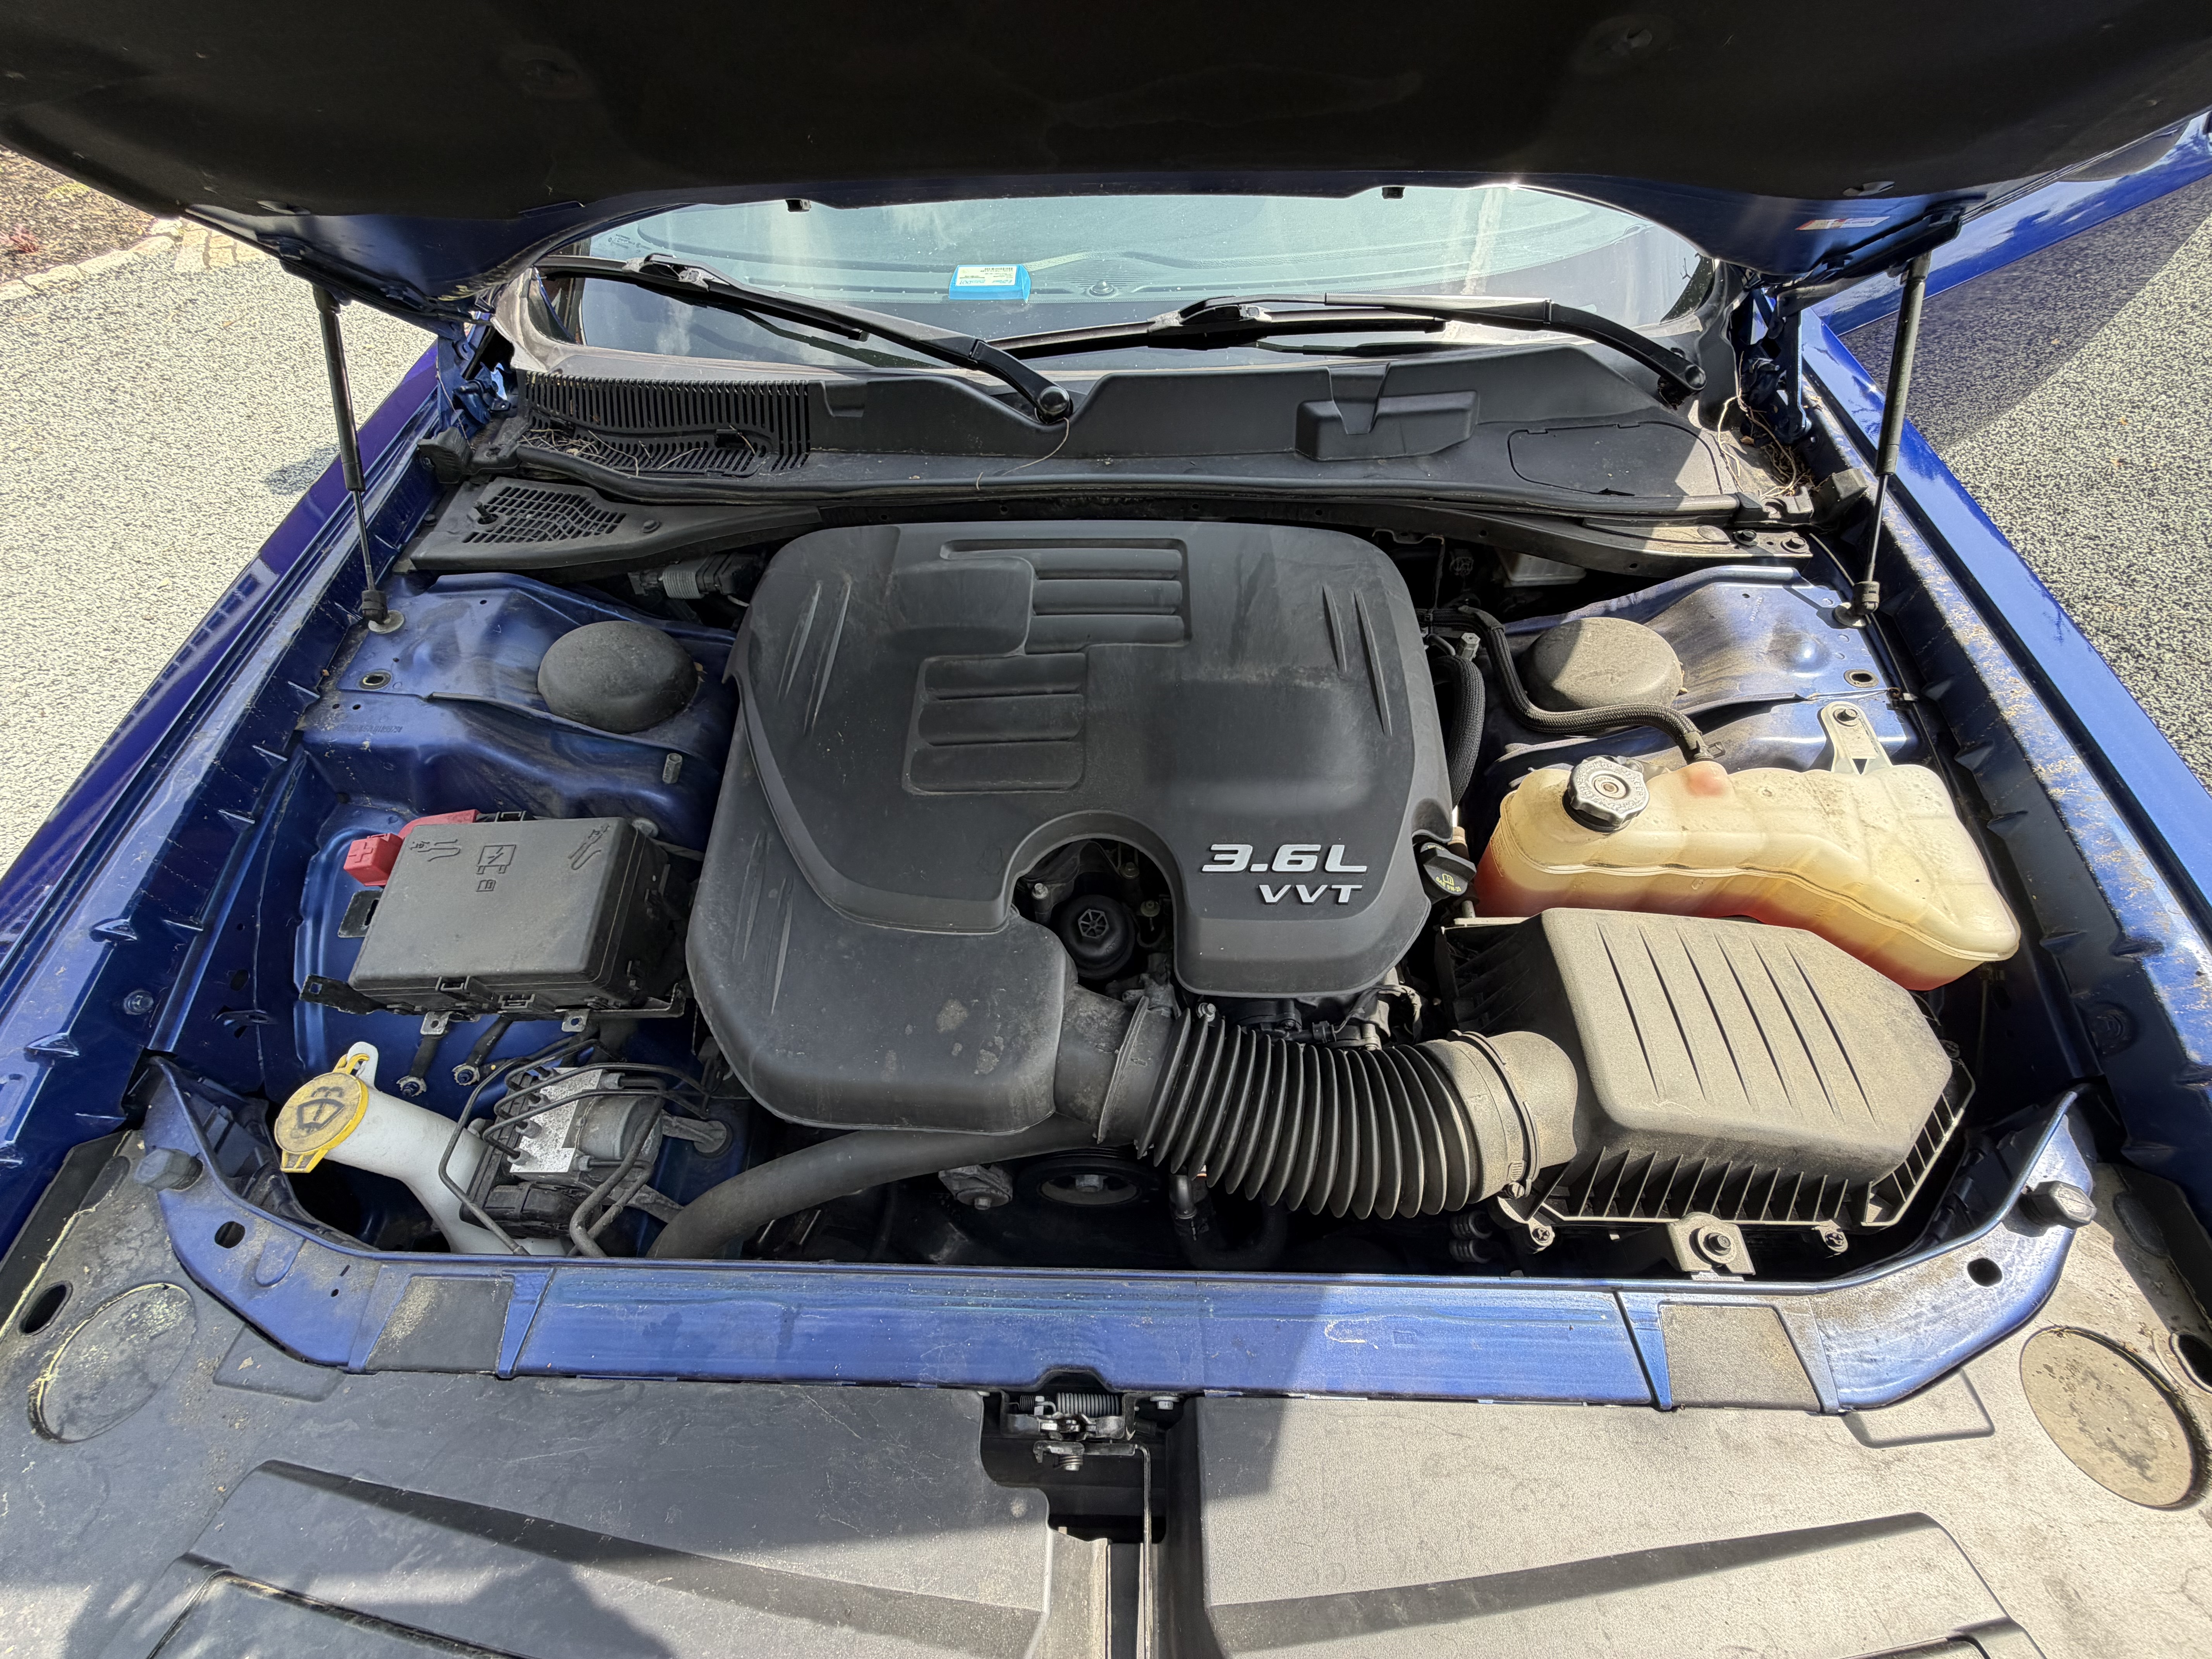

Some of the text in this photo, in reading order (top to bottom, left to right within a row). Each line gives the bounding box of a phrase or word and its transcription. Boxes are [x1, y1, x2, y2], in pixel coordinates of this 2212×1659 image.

[1202, 844, 1367, 872] 3.6L
[1436, 876, 1446, 887] SAE
[1258, 884, 1362, 905] VVT
